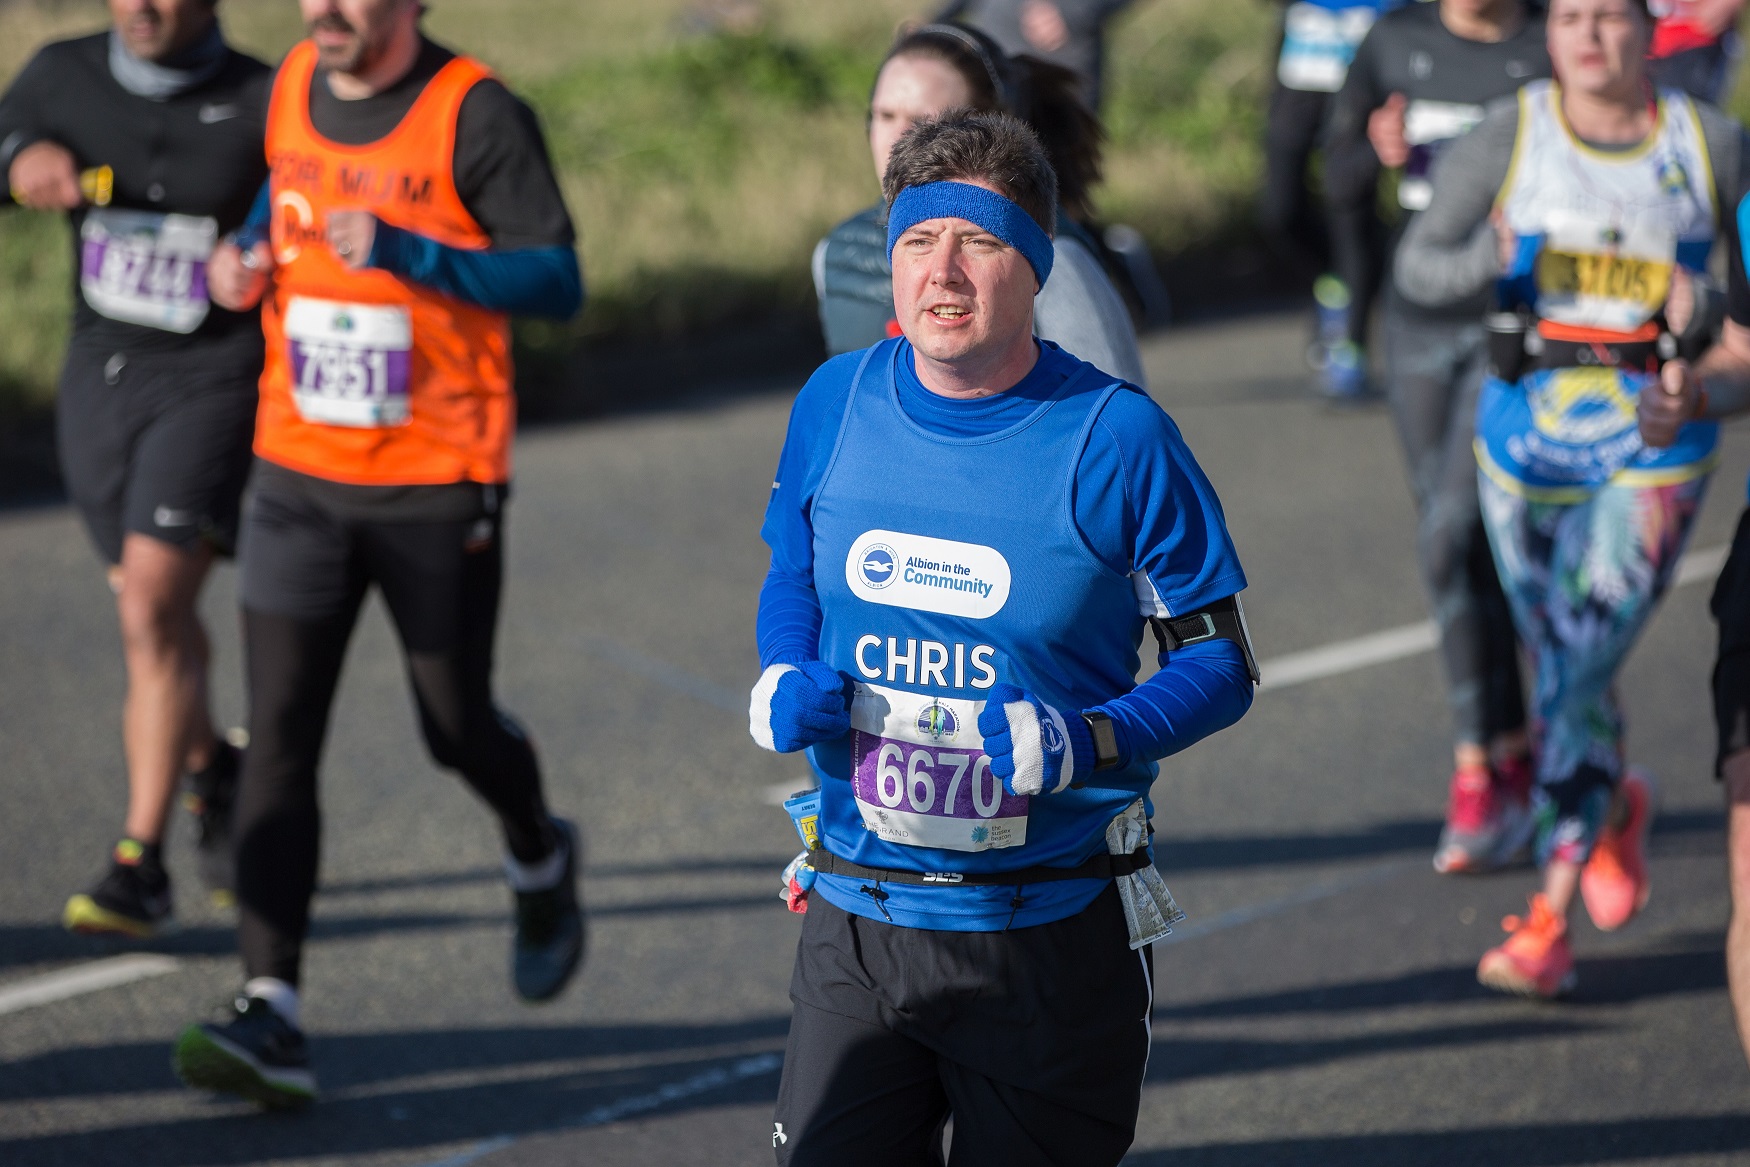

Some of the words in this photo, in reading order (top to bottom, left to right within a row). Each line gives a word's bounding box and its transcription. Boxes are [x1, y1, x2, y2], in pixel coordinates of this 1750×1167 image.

[302, 343, 388, 399] 7951
[906, 556, 940, 571] Albion
[941, 561, 951, 573] in
[953, 564, 971, 576] the
[904, 568, 993, 598] Community
[855, 634, 997, 689] CHRIS
[949, 707, 961, 732] MARATHON
[876, 743, 1003, 817] 6670
[879, 827, 909, 838] RAND
